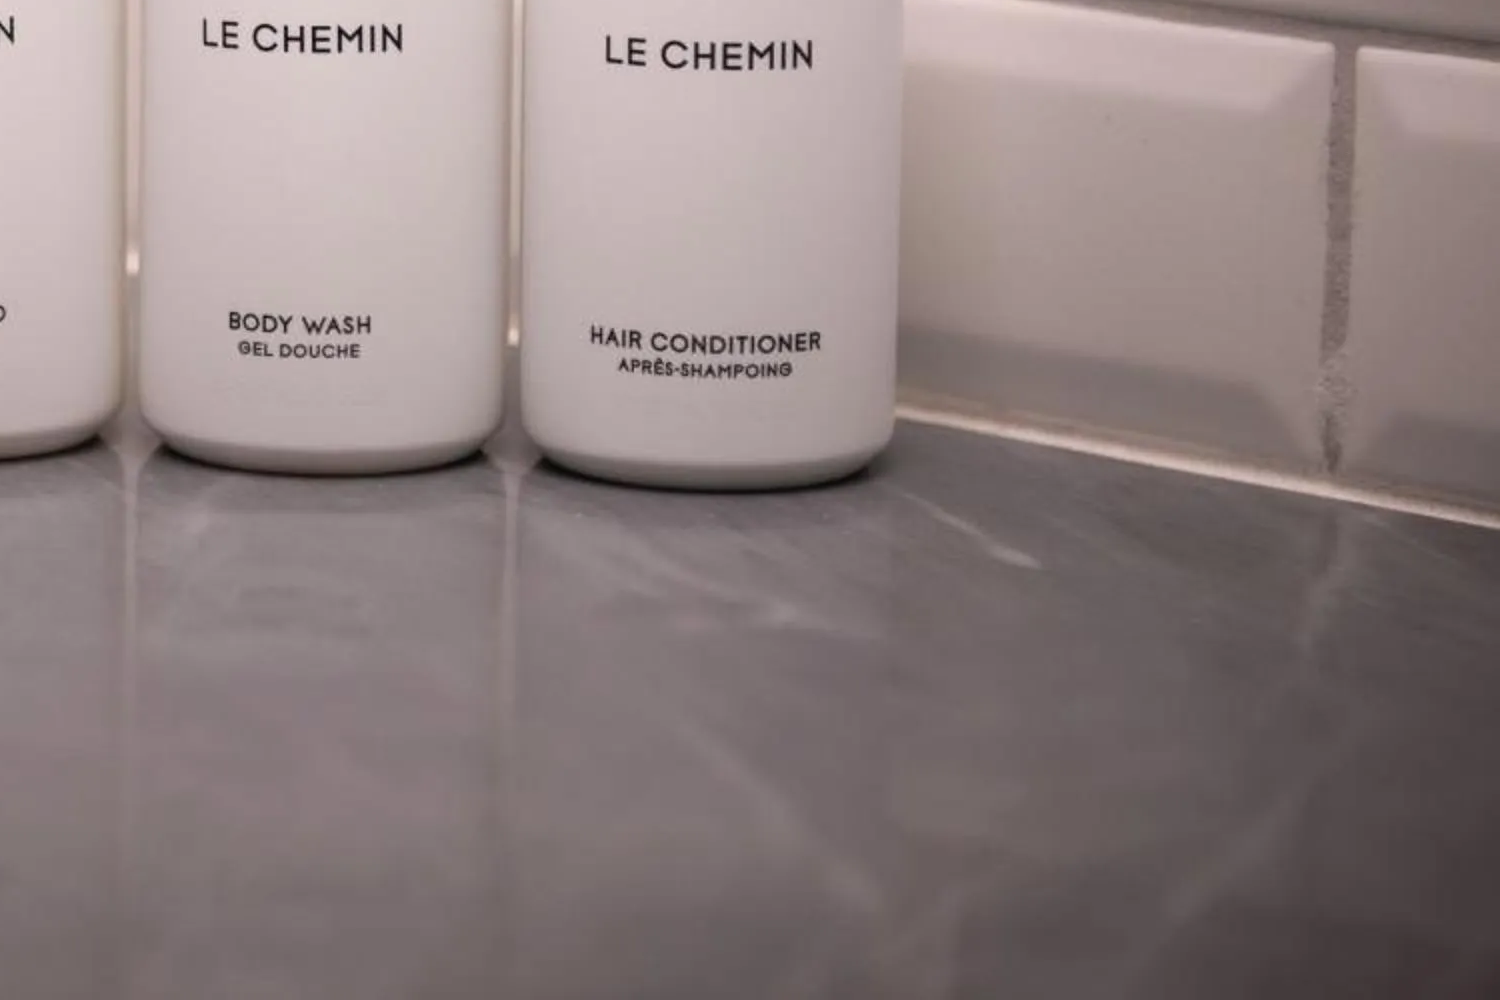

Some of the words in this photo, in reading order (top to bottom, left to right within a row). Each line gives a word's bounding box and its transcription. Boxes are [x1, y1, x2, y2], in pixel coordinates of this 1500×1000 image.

[202, 17, 240, 50] LE
[251, 23, 403, 55] CHEMIN
[605, 34, 647, 67] LE
[660, 39, 814, 72] CHEMIN
[228, 310, 294, 335] BODY
[301, 315, 372, 336] WASH
[237, 339, 274, 358] GEL
[278, 342, 361, 360] DOUCHE
[590, 324, 643, 350] HAIR
[649, 330, 822, 355] CONDITIONER
